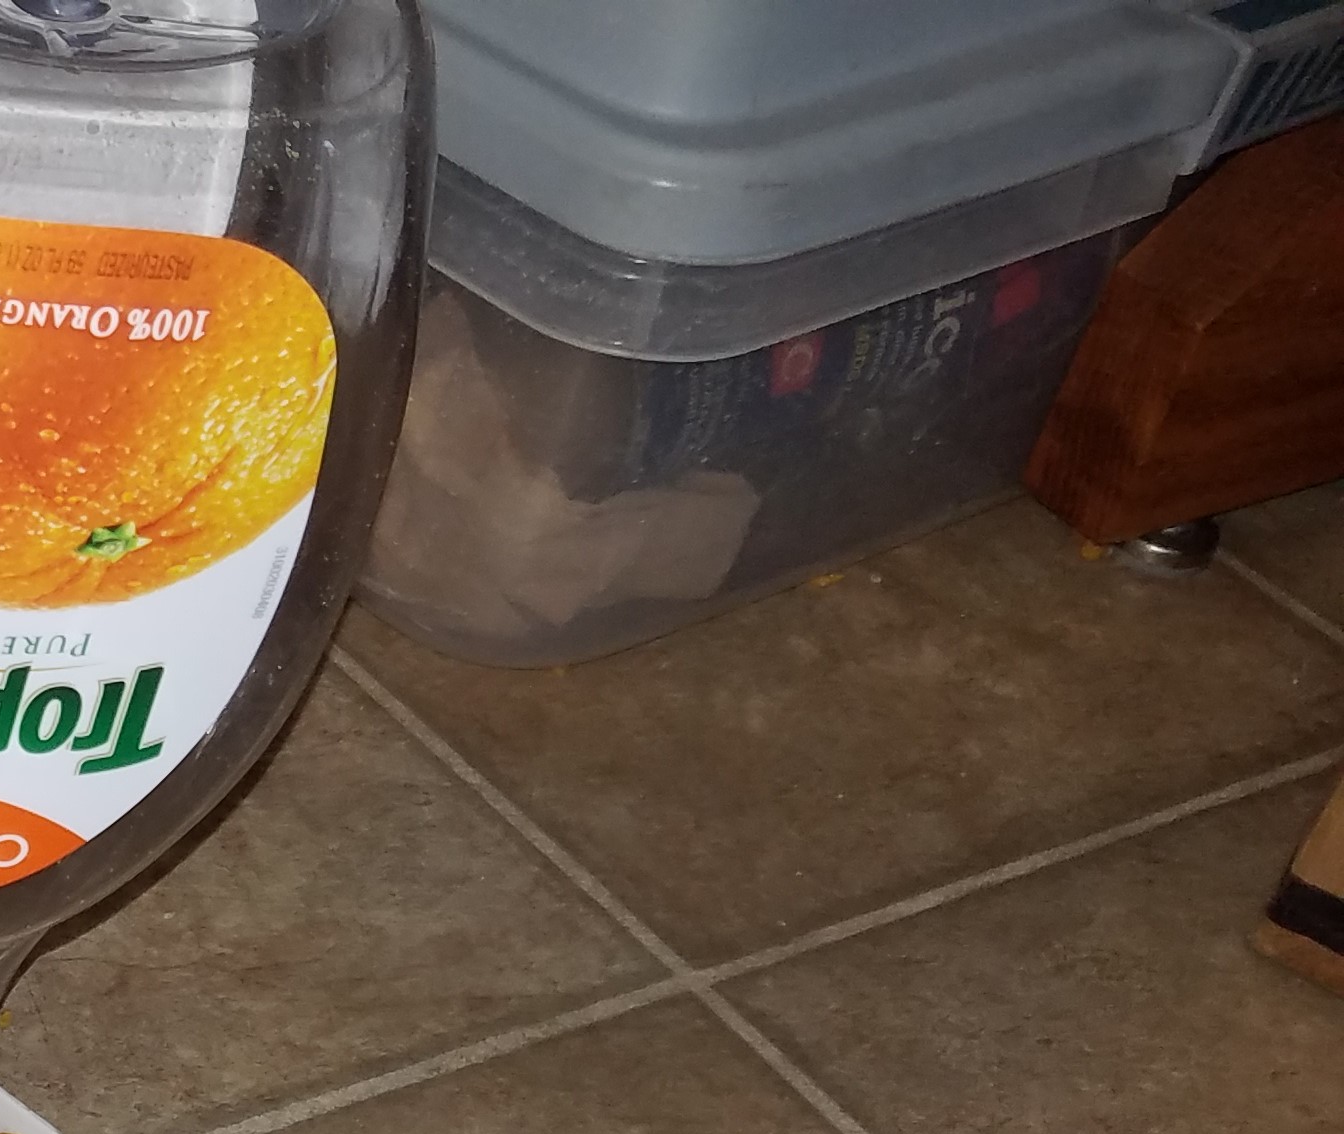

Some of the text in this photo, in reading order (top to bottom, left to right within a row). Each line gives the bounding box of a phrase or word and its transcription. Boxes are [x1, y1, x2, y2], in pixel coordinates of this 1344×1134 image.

[22, 246, 43, 272] OZ
[97, 251, 195, 281] PASTEURIZED
[127, 308, 210, 341] 100%
[2, 633, 92, 657] PURE
